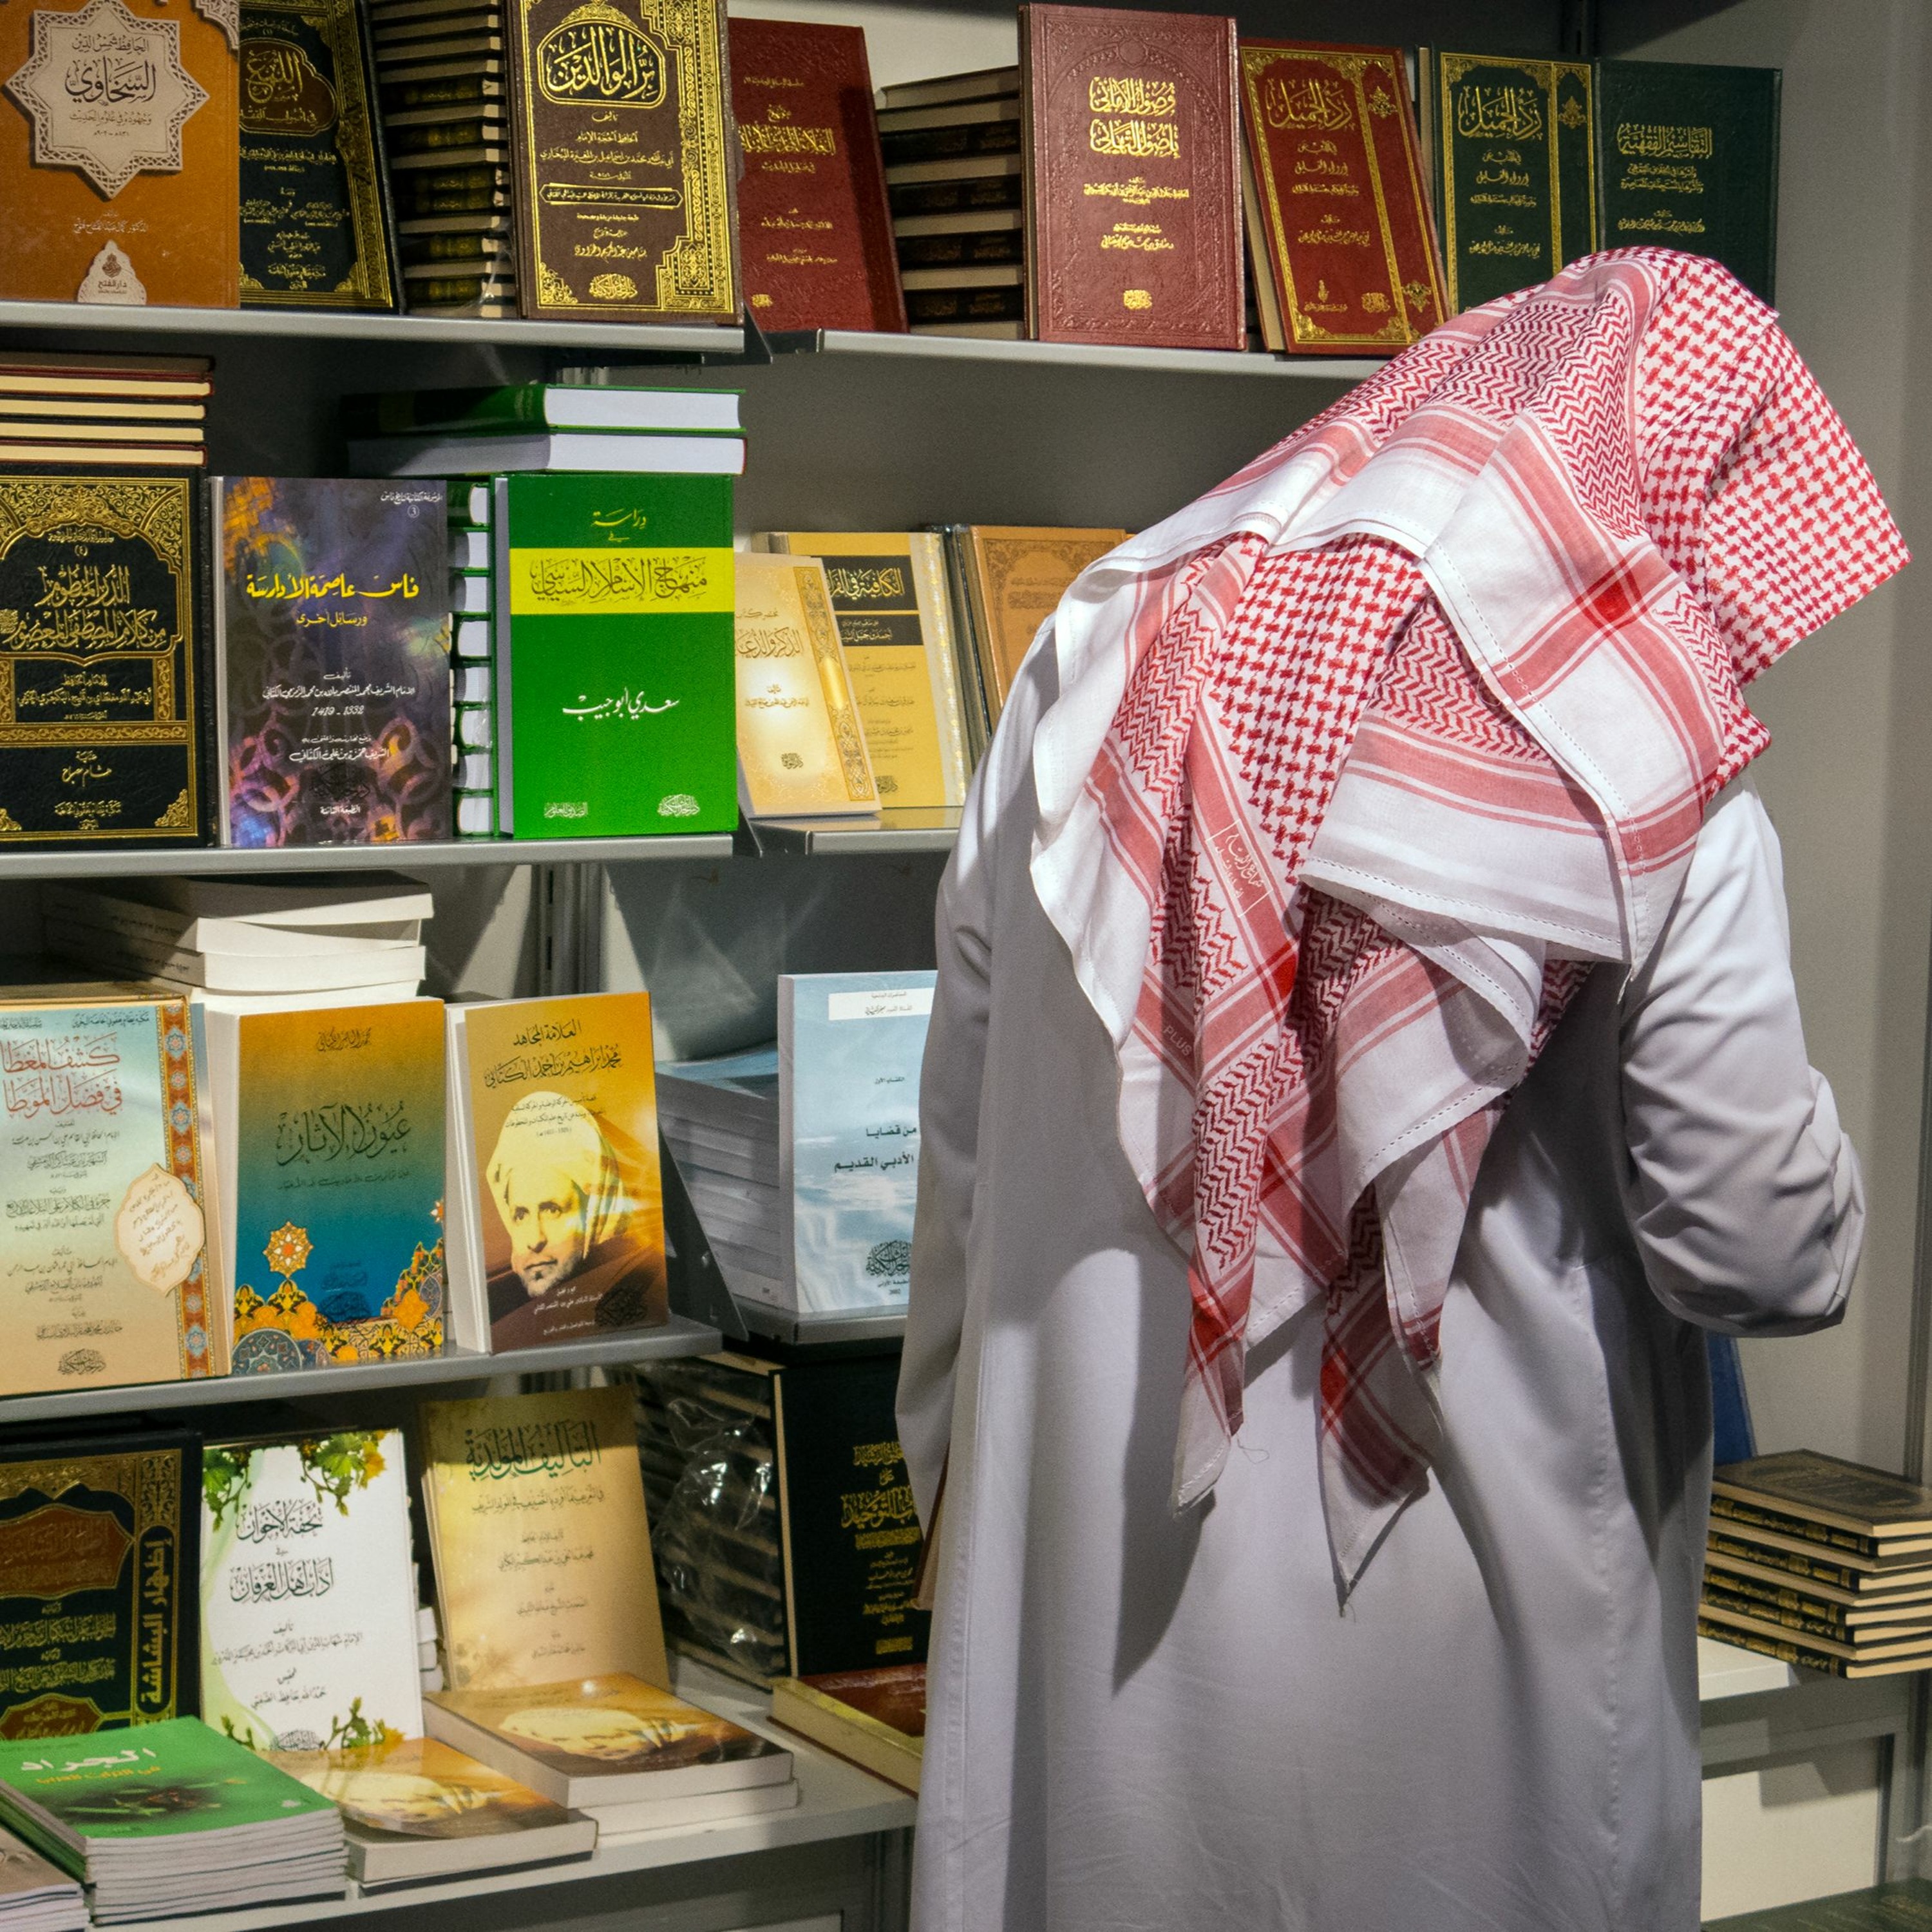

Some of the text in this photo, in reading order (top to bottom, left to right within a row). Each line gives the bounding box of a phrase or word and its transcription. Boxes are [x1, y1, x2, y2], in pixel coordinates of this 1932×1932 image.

[65, 55, 156, 106] السخاوي
[409, 506, 418, 516] 3
[591, 507, 647, 529] دراسة
[246, 573, 419, 600] فاس عاصمة الأدارسة
[654, 556, 708, 601] منهاج
[859, 568, 905, 598] الكافية
[296, 609, 368, 628] ورسائل أخرى
[773, 627, 805, 658] الذكر
[323, 667, 351, 681] تأليف
[262, 684, 283, 699] الكتاني
[304, 685, 316, 698] محمد
[355, 683, 372, 697] محمد
[370, 683, 396, 696] الشريف
[312, 705, 365, 716] 1332 1419
[562, 694, 614, 721] جيب
[628, 690, 681, 720] سعدي
[289, 746, 390, 761] الشريف حمزة بن علي الكتاني
[513, 1019, 582, 1048] العلامة المجاهد
[601, 1043, 623, 1070] محمد
[484, 1055, 533, 1088] الكتاني
[50, 1076, 105, 1115] فضل
[101, 1081, 123, 1115] في
[866, 1125, 917, 1139] من قضايا
[834, 1151, 914, 1173] الأدبي القديم
[289, 1502, 323, 1535] تحفة
[229, 1562, 283, 1605] العرفان
[272, 1623, 294, 1636] تأليف
[21, 1747, 157, 1772] الجراد
